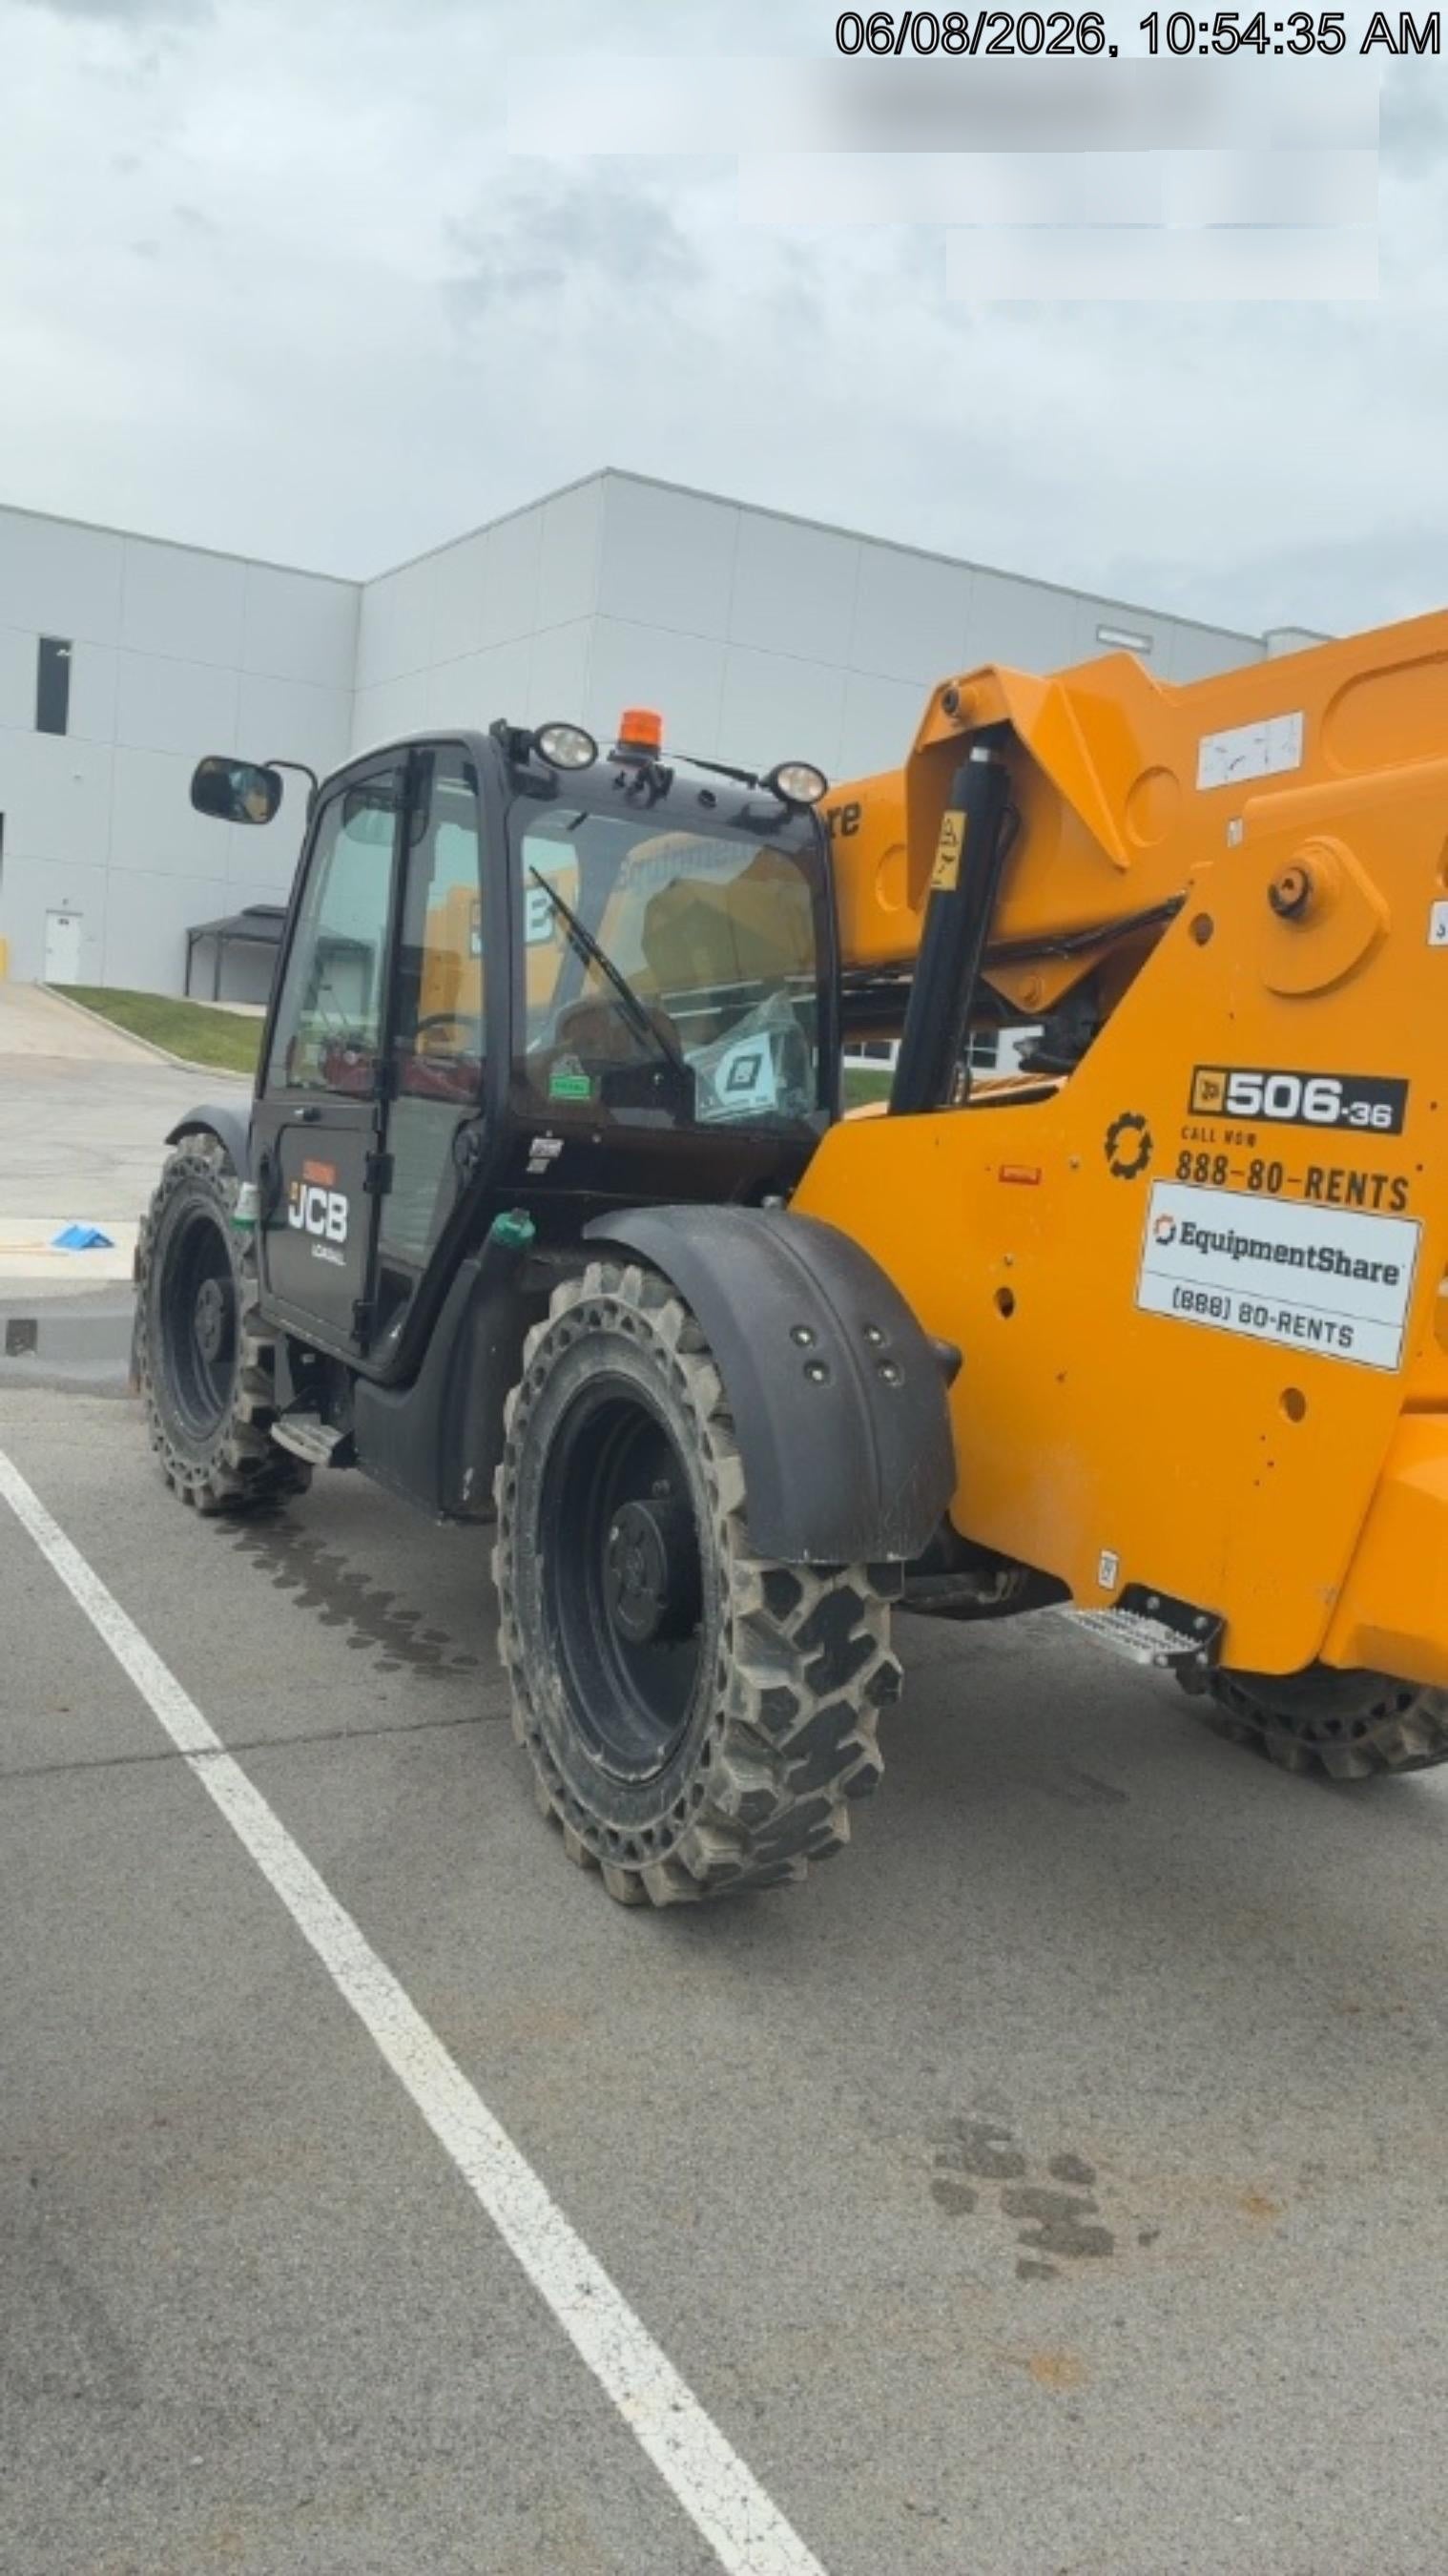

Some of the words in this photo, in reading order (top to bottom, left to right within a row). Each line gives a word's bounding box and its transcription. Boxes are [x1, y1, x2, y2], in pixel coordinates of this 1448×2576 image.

[1181, 1125, 1217, 1144] CALL
[1224, 1129, 1257, 1149] NOW
[288, 1180, 348, 1243] JCB
[1176, 1150, 1410, 1211] 888-80-RENTS
[1180, 1221, 1400, 1286] EquipmentShare
[1172, 1285, 1231, 1320] (888)
[1238, 1303, 1355, 1348] 80-RENTS
